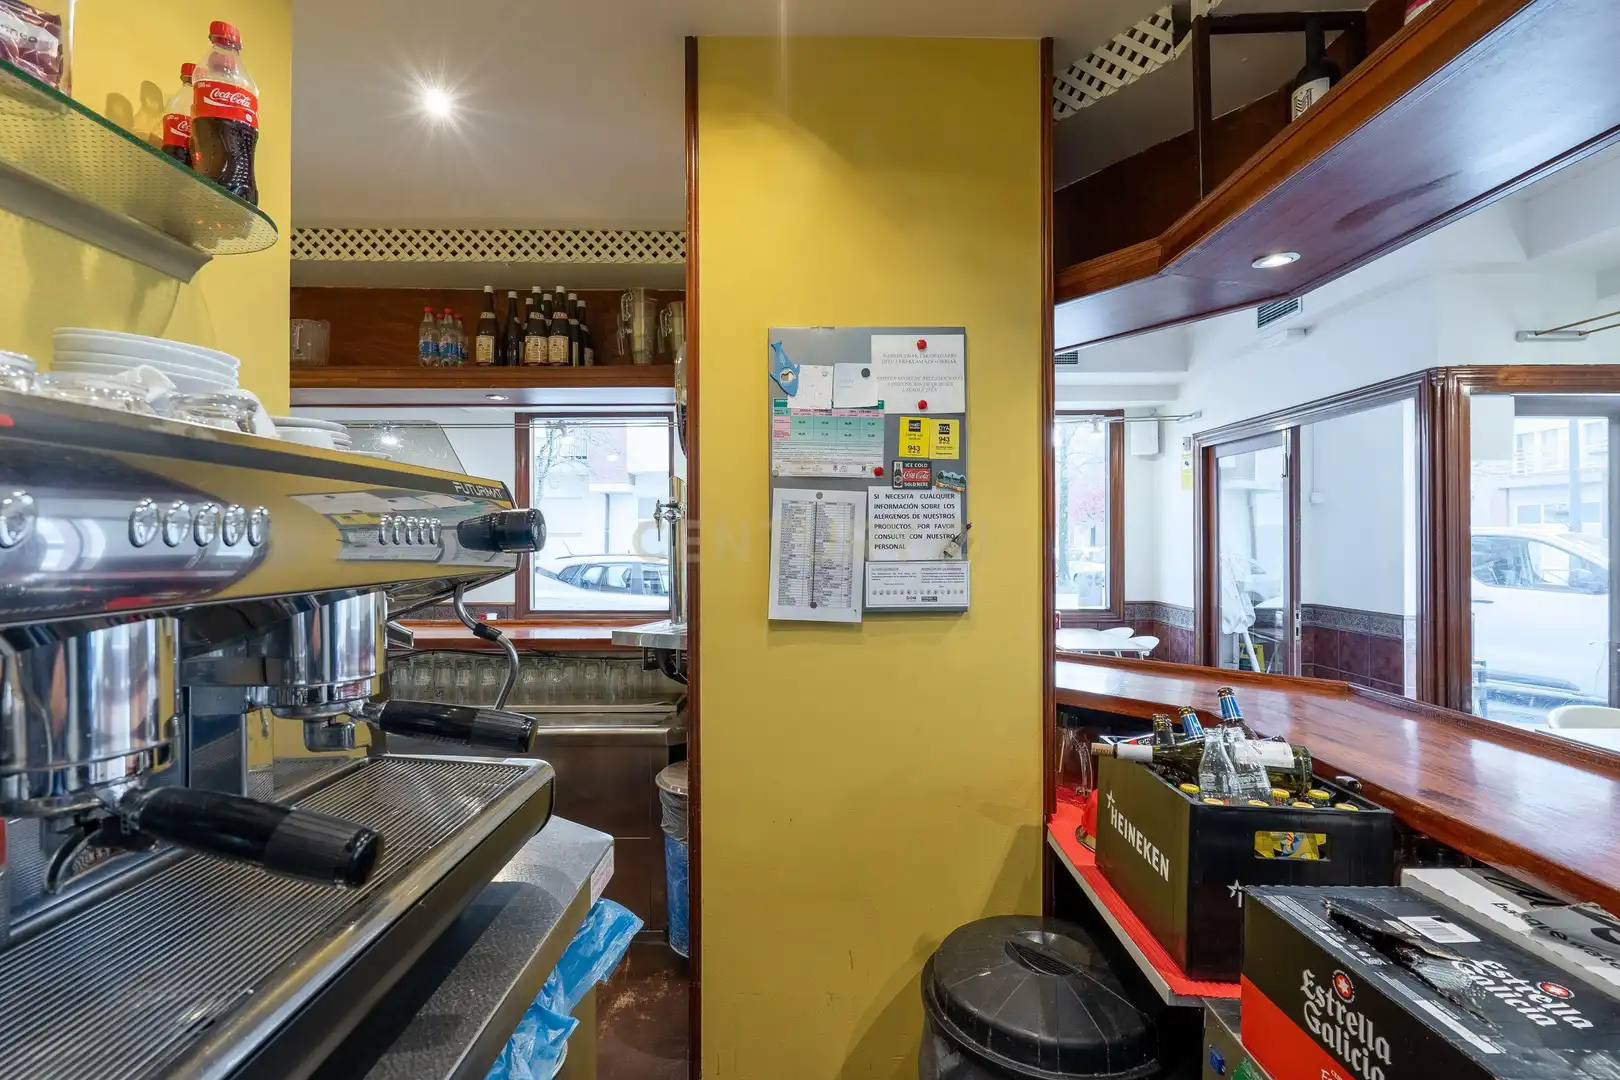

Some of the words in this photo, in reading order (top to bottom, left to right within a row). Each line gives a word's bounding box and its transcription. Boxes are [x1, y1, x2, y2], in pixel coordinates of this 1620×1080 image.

[210, 88, 251, 108] Coca-Cola
[452, 481, 503, 499] FUTURMAT
[1110, 805, 1170, 882] HEINEKEN
[1300, 968, 1392, 1066] Estrella
[1468, 959, 1594, 1029] Estrella
